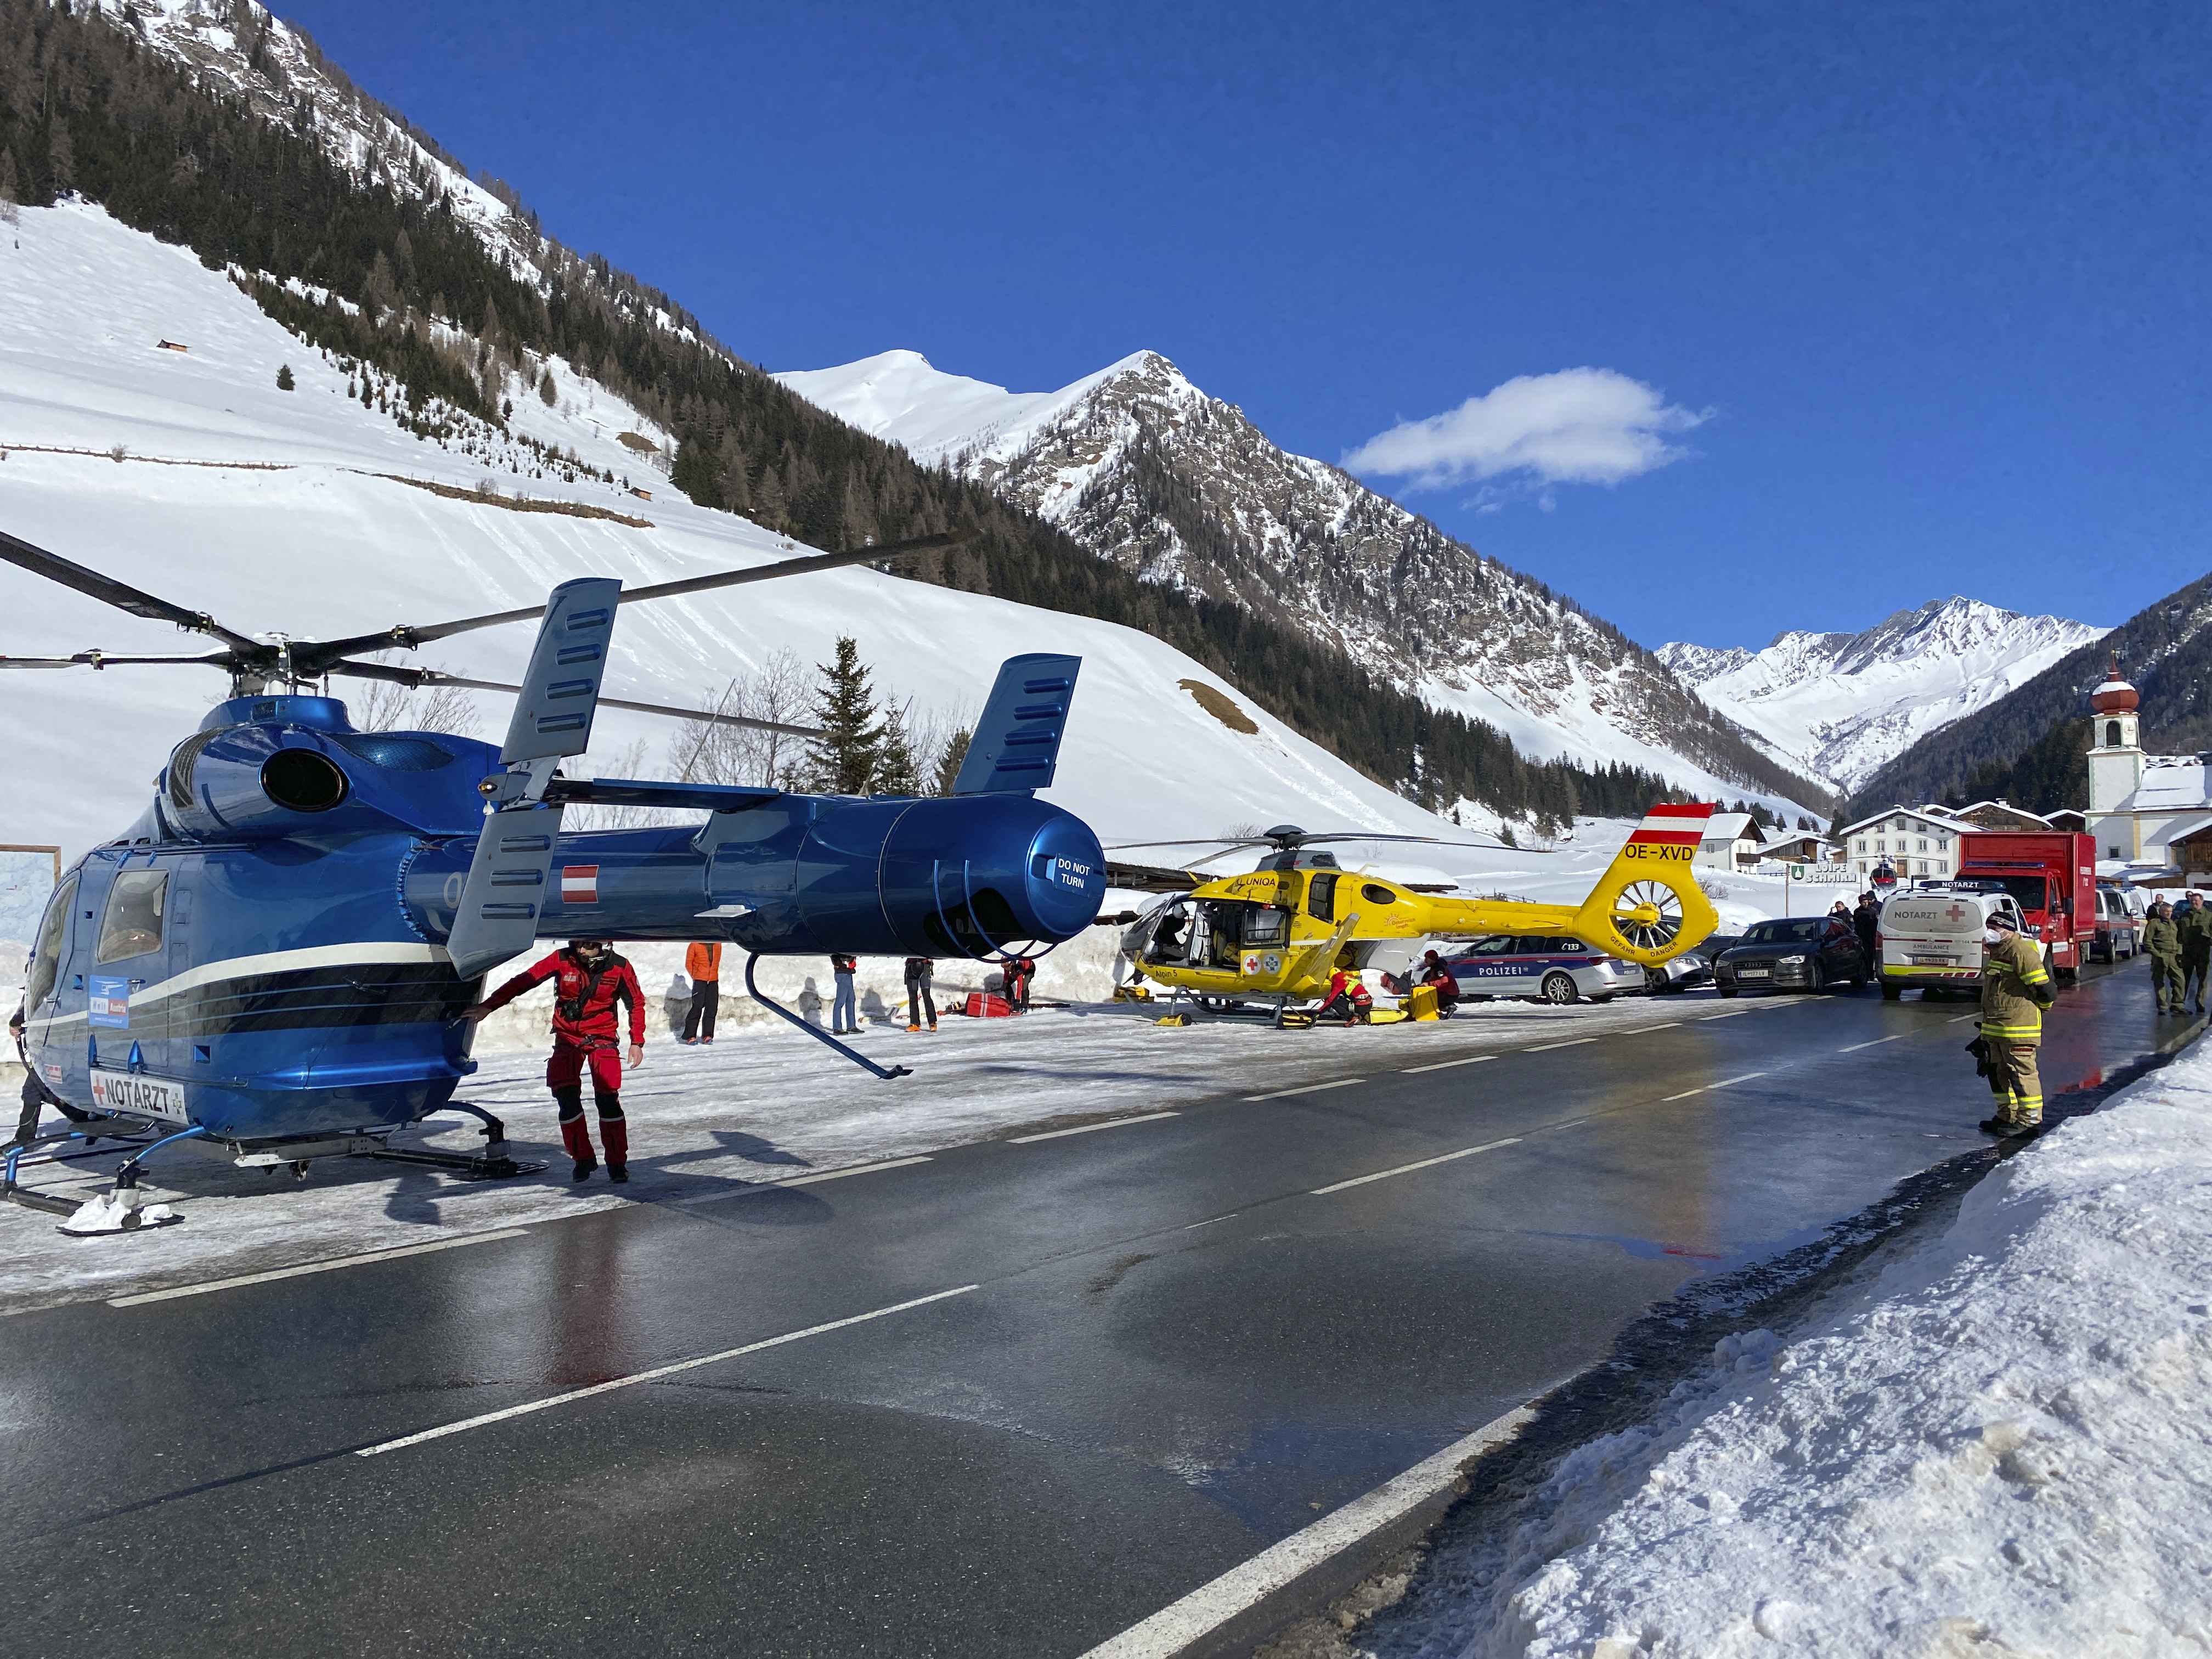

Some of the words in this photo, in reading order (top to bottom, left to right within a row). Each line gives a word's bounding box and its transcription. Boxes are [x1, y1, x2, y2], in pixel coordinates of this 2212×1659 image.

[1625, 844, 1692, 861] OE-XVD
[1058, 858, 1071, 870] DO
[1073, 862, 1090, 876] NOT
[1061, 873, 1084, 889] TURN
[1246, 877, 1276, 886] UNIQA
[1894, 911, 1938, 919] NOTARZT
[1610, 936, 1636, 956] GEFAHR
[1650, 941, 1678, 957] DANGER
[1155, 969, 1172, 979] Alpin
[1479, 967, 1521, 975] POLIZEI
[105, 1079, 168, 1114] NOTARZT
